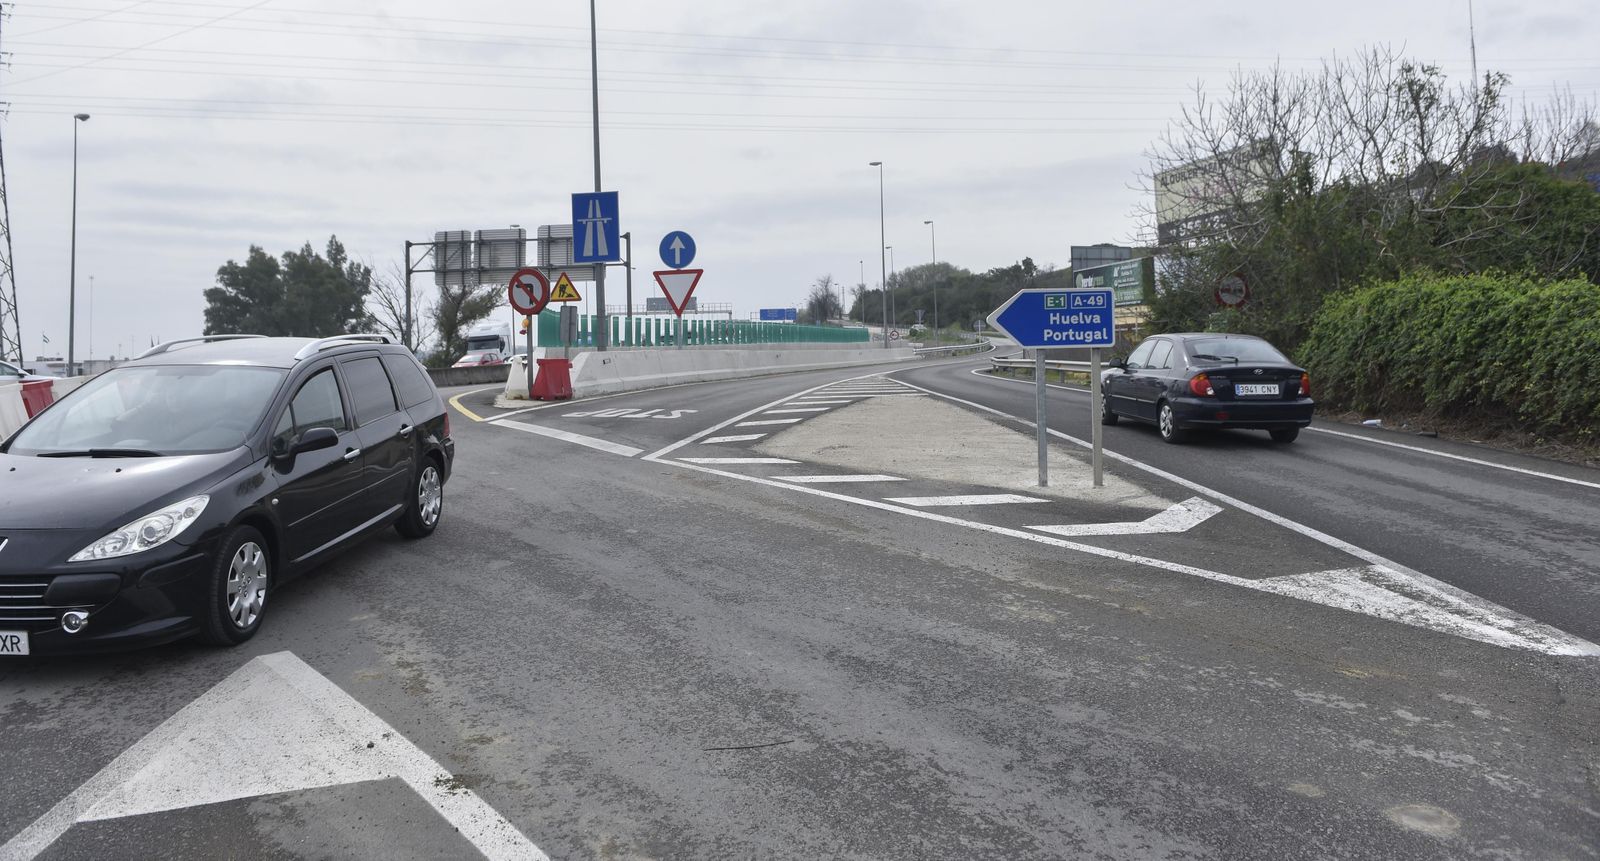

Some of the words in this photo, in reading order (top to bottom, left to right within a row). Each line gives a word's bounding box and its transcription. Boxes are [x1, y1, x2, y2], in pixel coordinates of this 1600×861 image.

[1046, 296, 1065, 307] E-1
[1073, 295, 1104, 306] A-49
[1049, 311, 1101, 325] Huelva
[1043, 327, 1108, 342] Portugal
[1240, 385, 1258, 395] 3941
[1261, 385, 1278, 395] CNY
